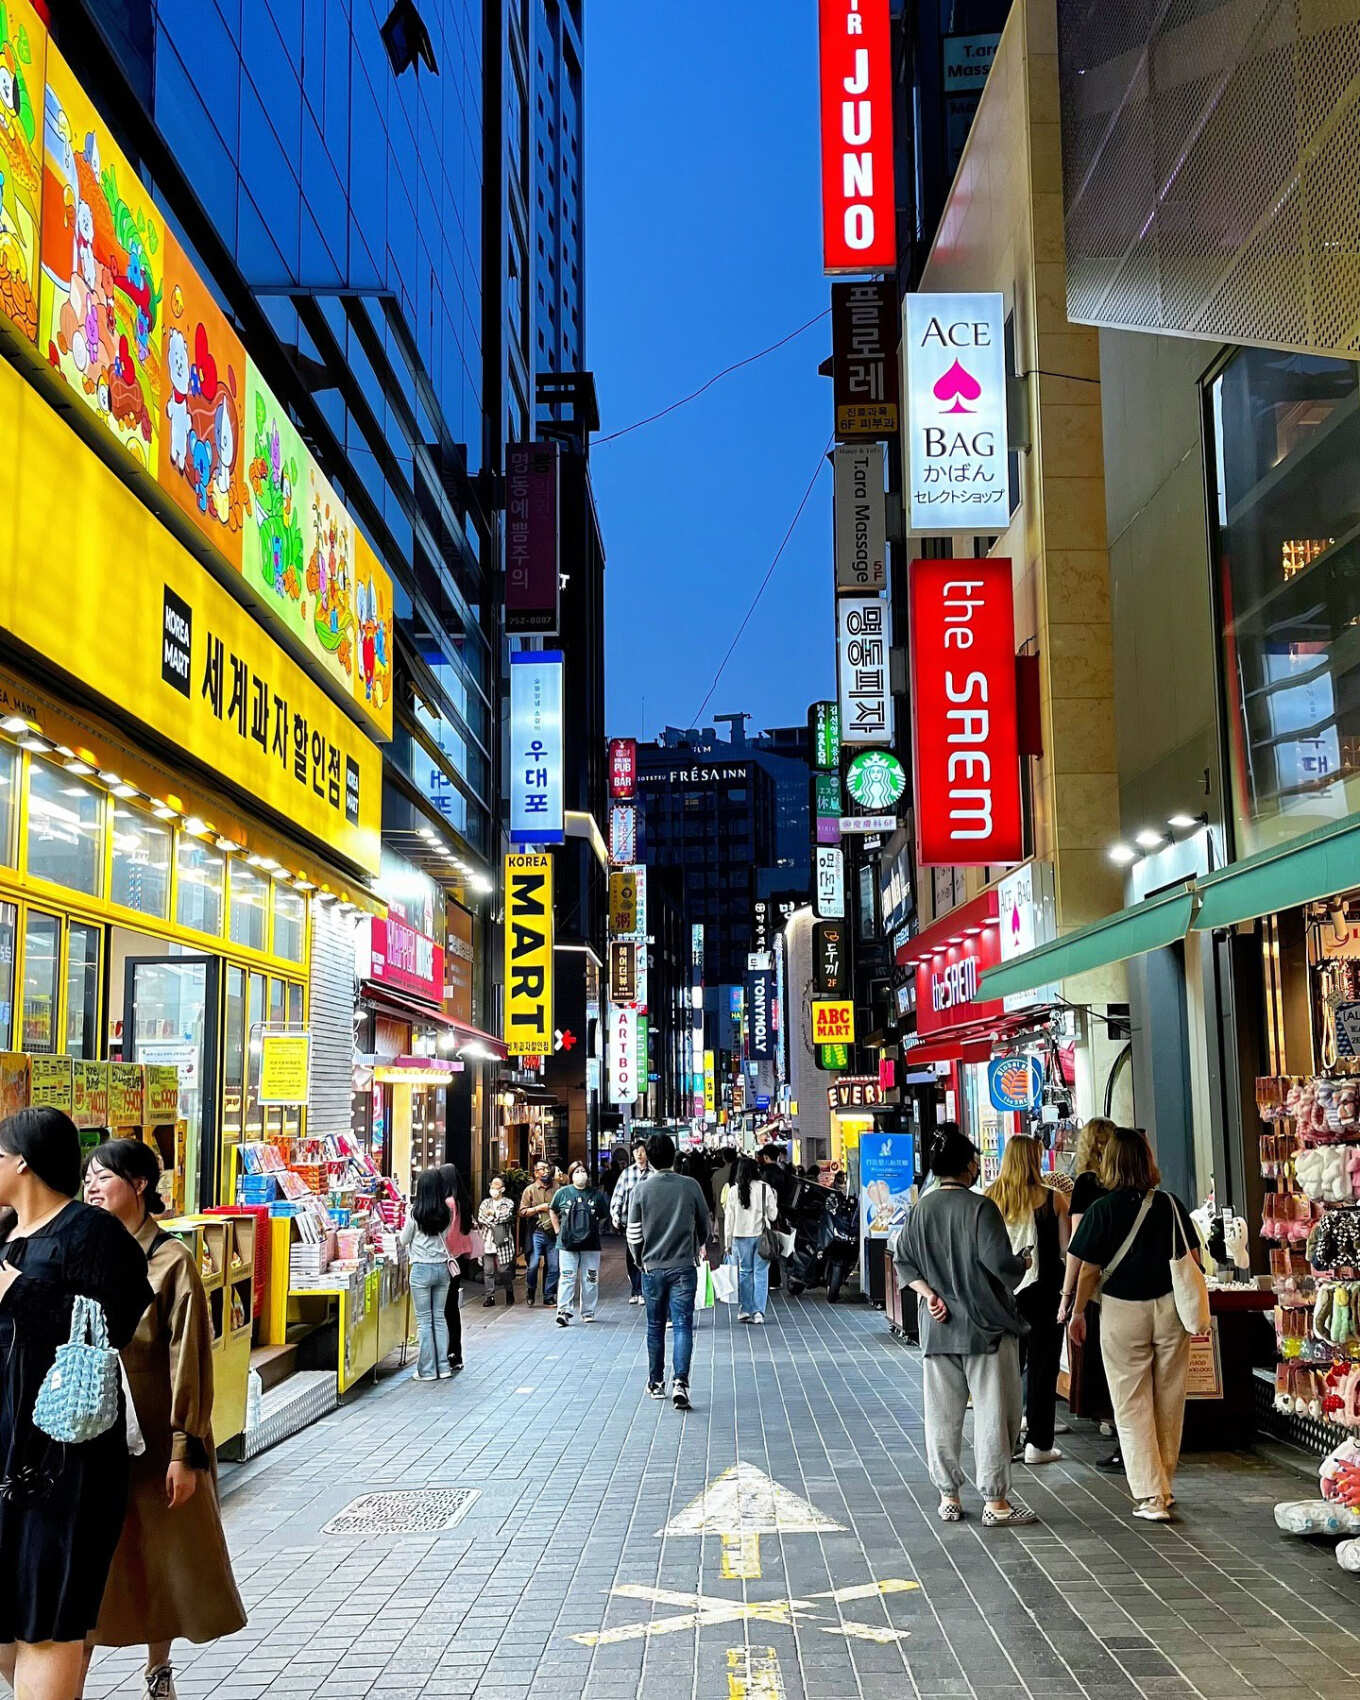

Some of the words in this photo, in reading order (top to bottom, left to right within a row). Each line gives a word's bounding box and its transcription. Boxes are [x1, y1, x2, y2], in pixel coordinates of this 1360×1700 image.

[842, 48, 875, 250] JUNO
[921, 317, 991, 347] ACE
[923, 427, 995, 457] BAG
[853, 457, 869, 498] T.ara
[923, 464, 995, 483] かばん
[914, 489, 1005, 504] セレクトショップ
[852, 504, 870, 582] Massage
[164, 605, 190, 648] KOREA
[943, 581, 984, 649] the
[164, 644, 190, 679] MART
[202, 631, 341, 810] 세계과자할인점
[817, 732, 828, 765] SALON
[525, 740, 548, 813] 우대포
[614, 763, 631, 773] PUB
[614, 777, 631, 787] BAR
[722, 768, 746, 779] INN
[508, 857, 549, 867] KOREA
[511, 874, 546, 1034] MART
[824, 943, 840, 976] 두끼
[827, 978, 837, 988] 2F
[754, 977, 767, 1053] TONYMOLY
[817, 1008, 850, 1025] ABC
[817, 1024, 850, 1037] MART
[618, 1013, 631, 1097] ARTBOX
